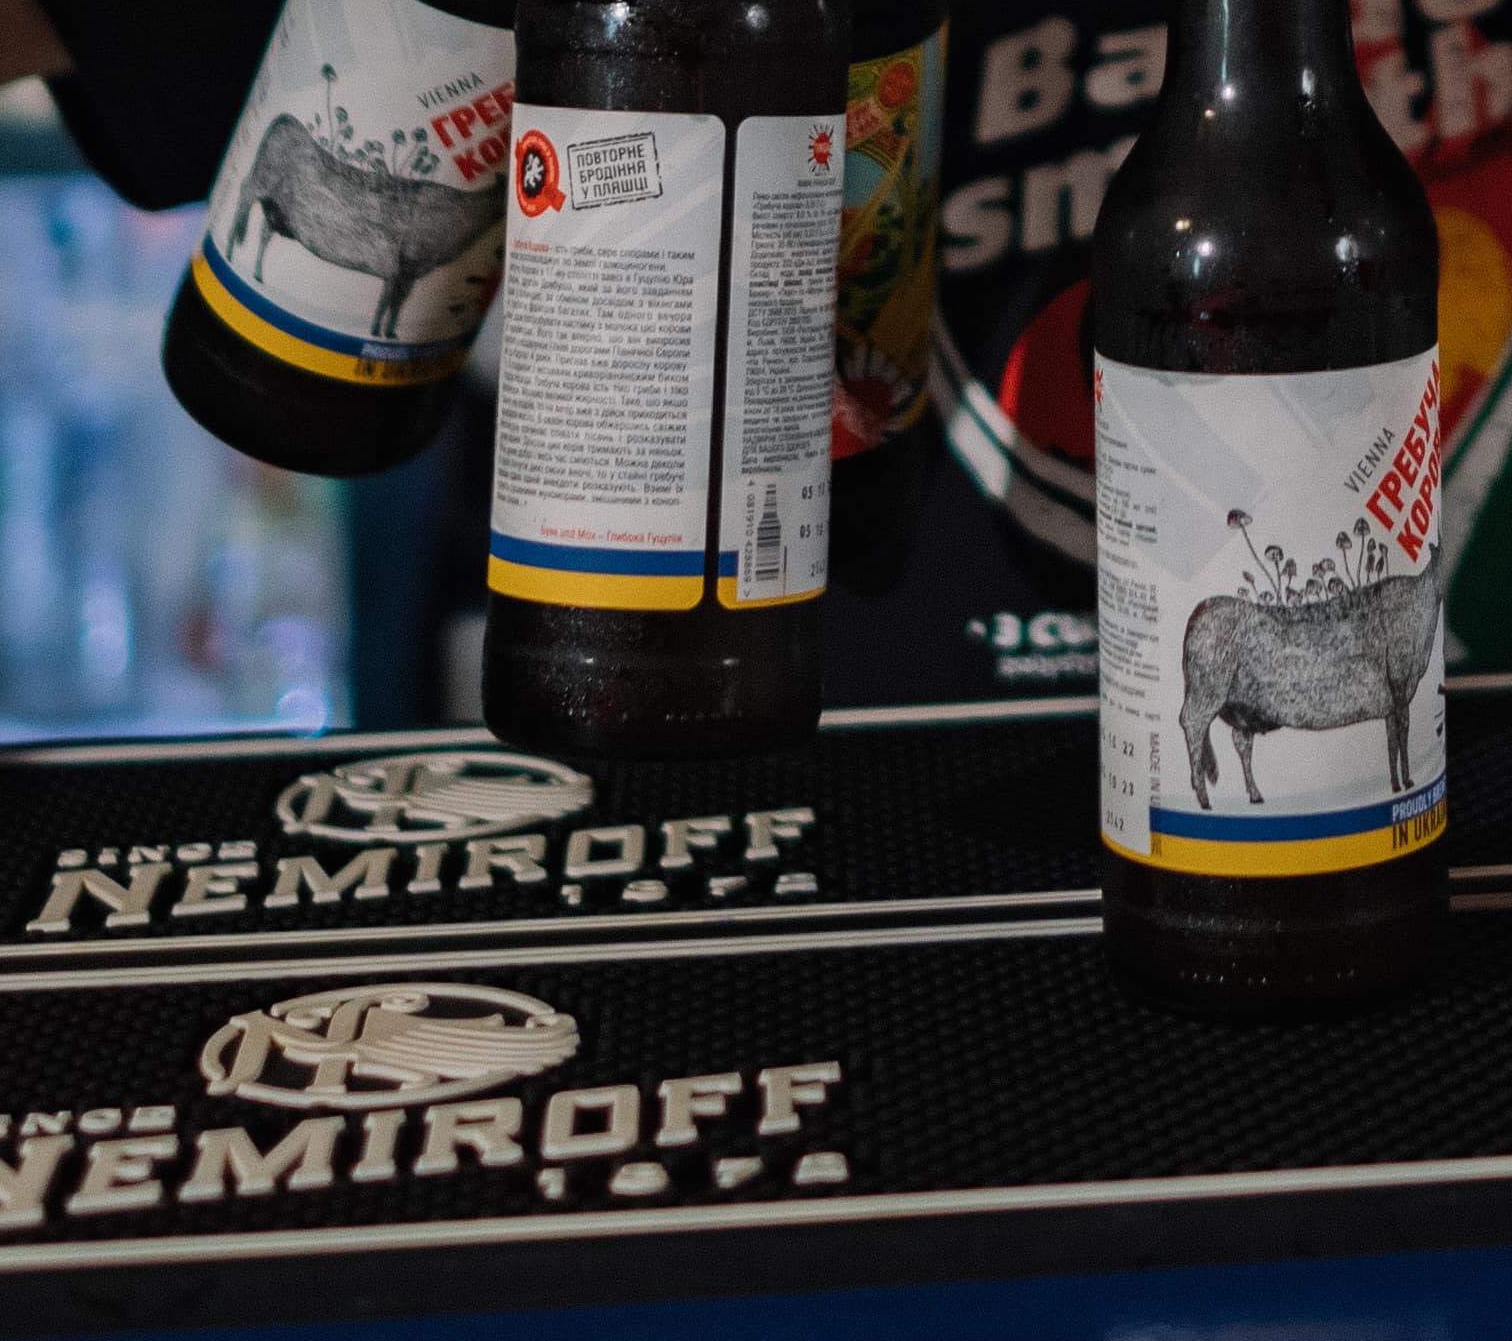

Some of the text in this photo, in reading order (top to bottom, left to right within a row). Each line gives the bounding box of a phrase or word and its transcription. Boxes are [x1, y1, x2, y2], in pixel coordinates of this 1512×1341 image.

[417, 71, 485, 109] VIENNA
[576, 143, 645, 168] ПОВТОРНЕ
[580, 161, 646, 184] БРОДІННЯ
[581, 177, 648, 199] У ПЛЯШЦІ
[1344, 428, 1395, 493] VIENNA
[1392, 791, 1432, 823] PROUDLY
[1392, 818, 1409, 849] IN
[26, 807, 814, 933] NEMIROFF
